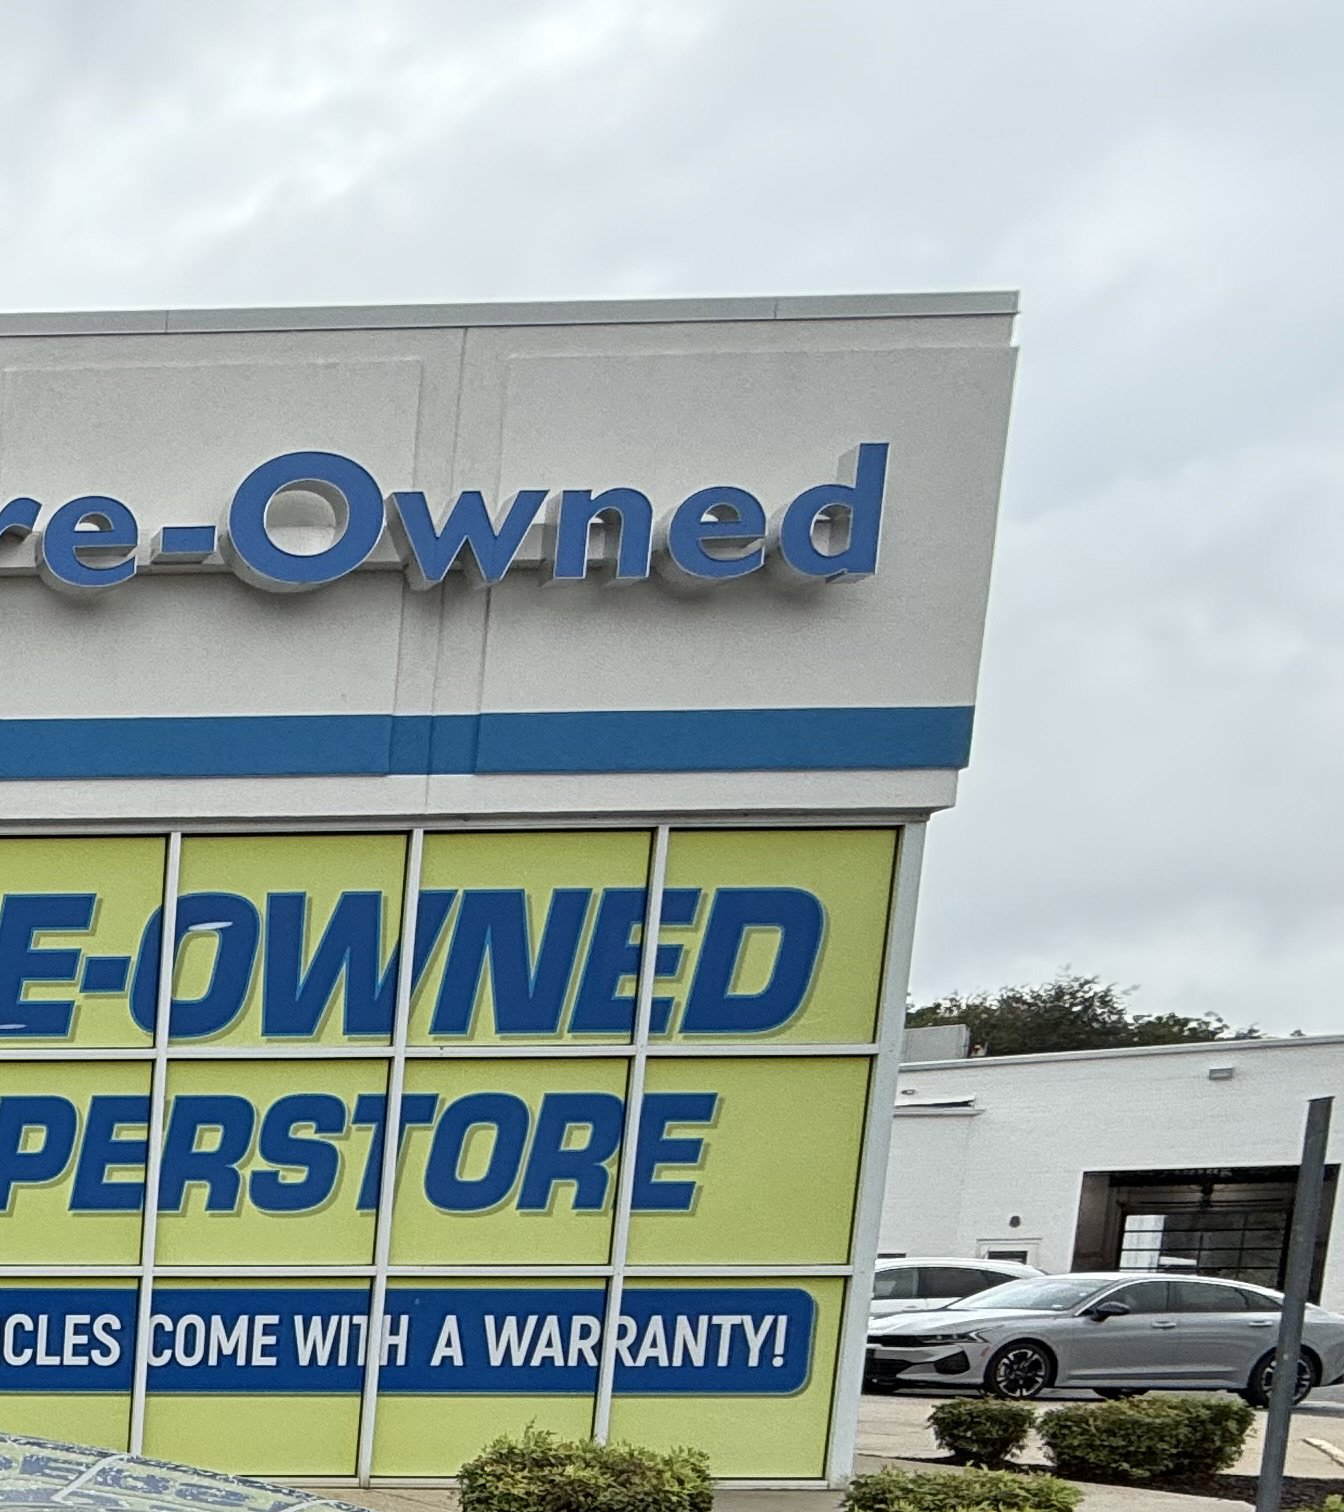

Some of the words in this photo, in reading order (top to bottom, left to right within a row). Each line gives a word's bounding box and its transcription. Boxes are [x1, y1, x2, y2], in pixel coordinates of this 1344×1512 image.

[145, 1314, 280, 1366] COME
[293, 1314, 410, 1367] WITH
[430, 1315, 464, 1367] A
[484, 1315, 789, 1368] WARRANTY!
